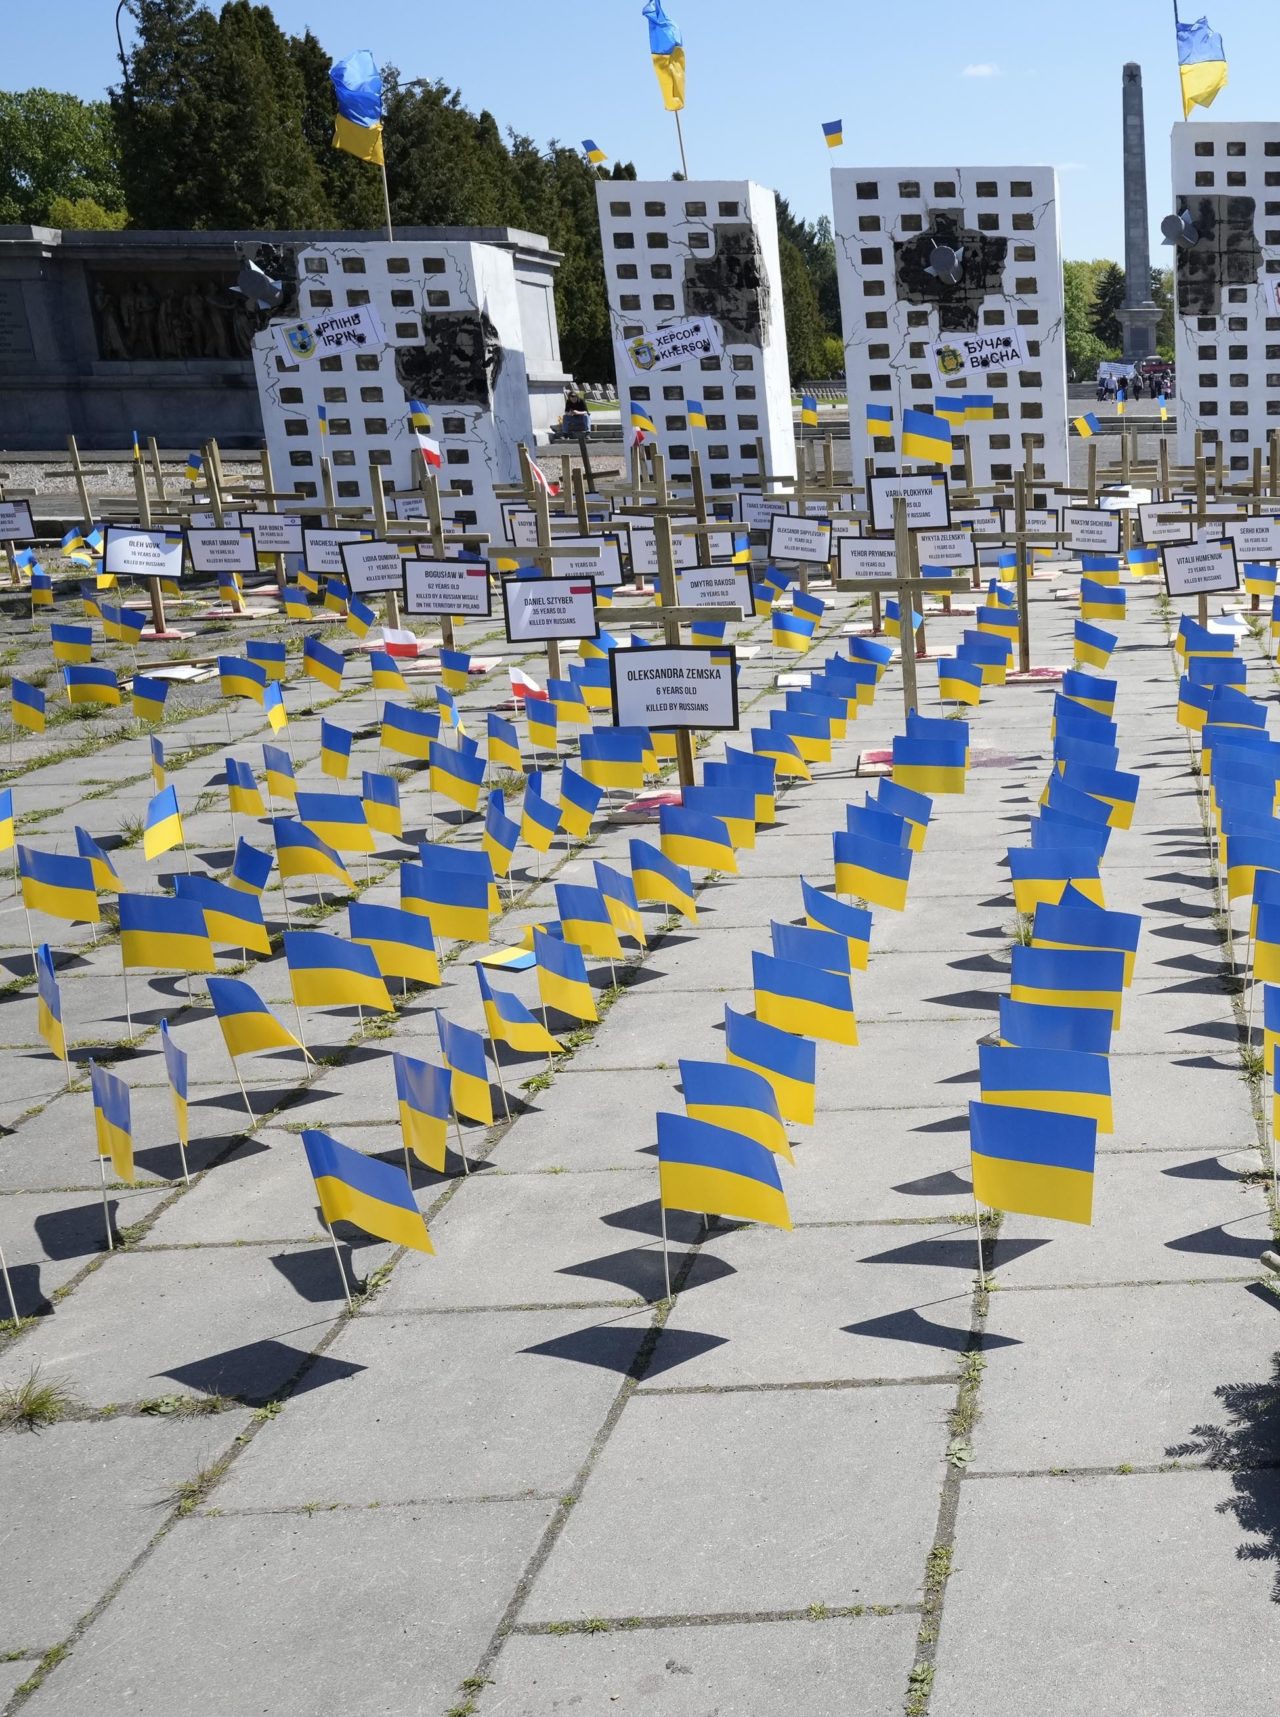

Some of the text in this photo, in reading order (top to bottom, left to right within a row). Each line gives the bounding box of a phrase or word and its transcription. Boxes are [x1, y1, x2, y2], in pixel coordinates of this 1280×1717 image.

[323, 330, 357, 346] IRPIN
[690, 580, 713, 589] DMYTRO
[524, 596, 574, 606] DANIEL SZTYBER
[628, 668, 721, 681] OLEKSANDRA ZEMSKA
[656, 687, 660, 695] 6
[646, 703, 708, 712] KILLED BY RUSSIANS
